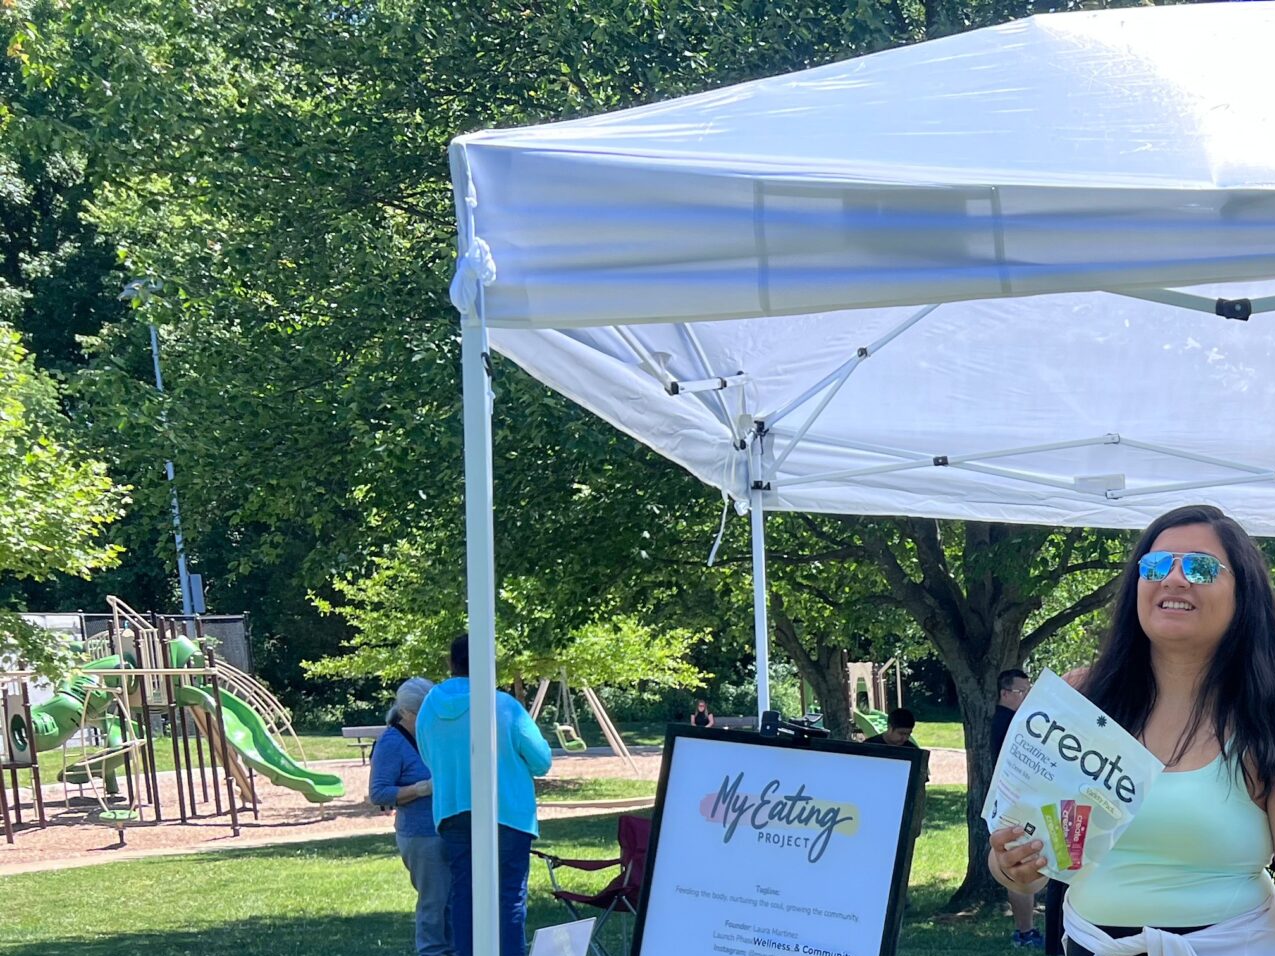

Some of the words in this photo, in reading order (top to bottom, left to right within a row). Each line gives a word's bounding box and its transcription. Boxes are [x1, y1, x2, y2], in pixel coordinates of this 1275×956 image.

[1014, 733, 1051, 764] Creatine
[1025, 711, 1136, 804] create
[1009, 743, 1055, 782] Electrolytes
[710, 772, 754, 844] My
[751, 779, 853, 864] Eating
[1073, 815, 1083, 842] create
[757, 831, 811, 849] PROJECT
[713, 931, 734, 940] Launch
[753, 925, 771, 934] Laura
[772, 928, 799, 938] Martinez
[753, 936, 791, 951] Wellness
[794, 943, 800, 952] &
